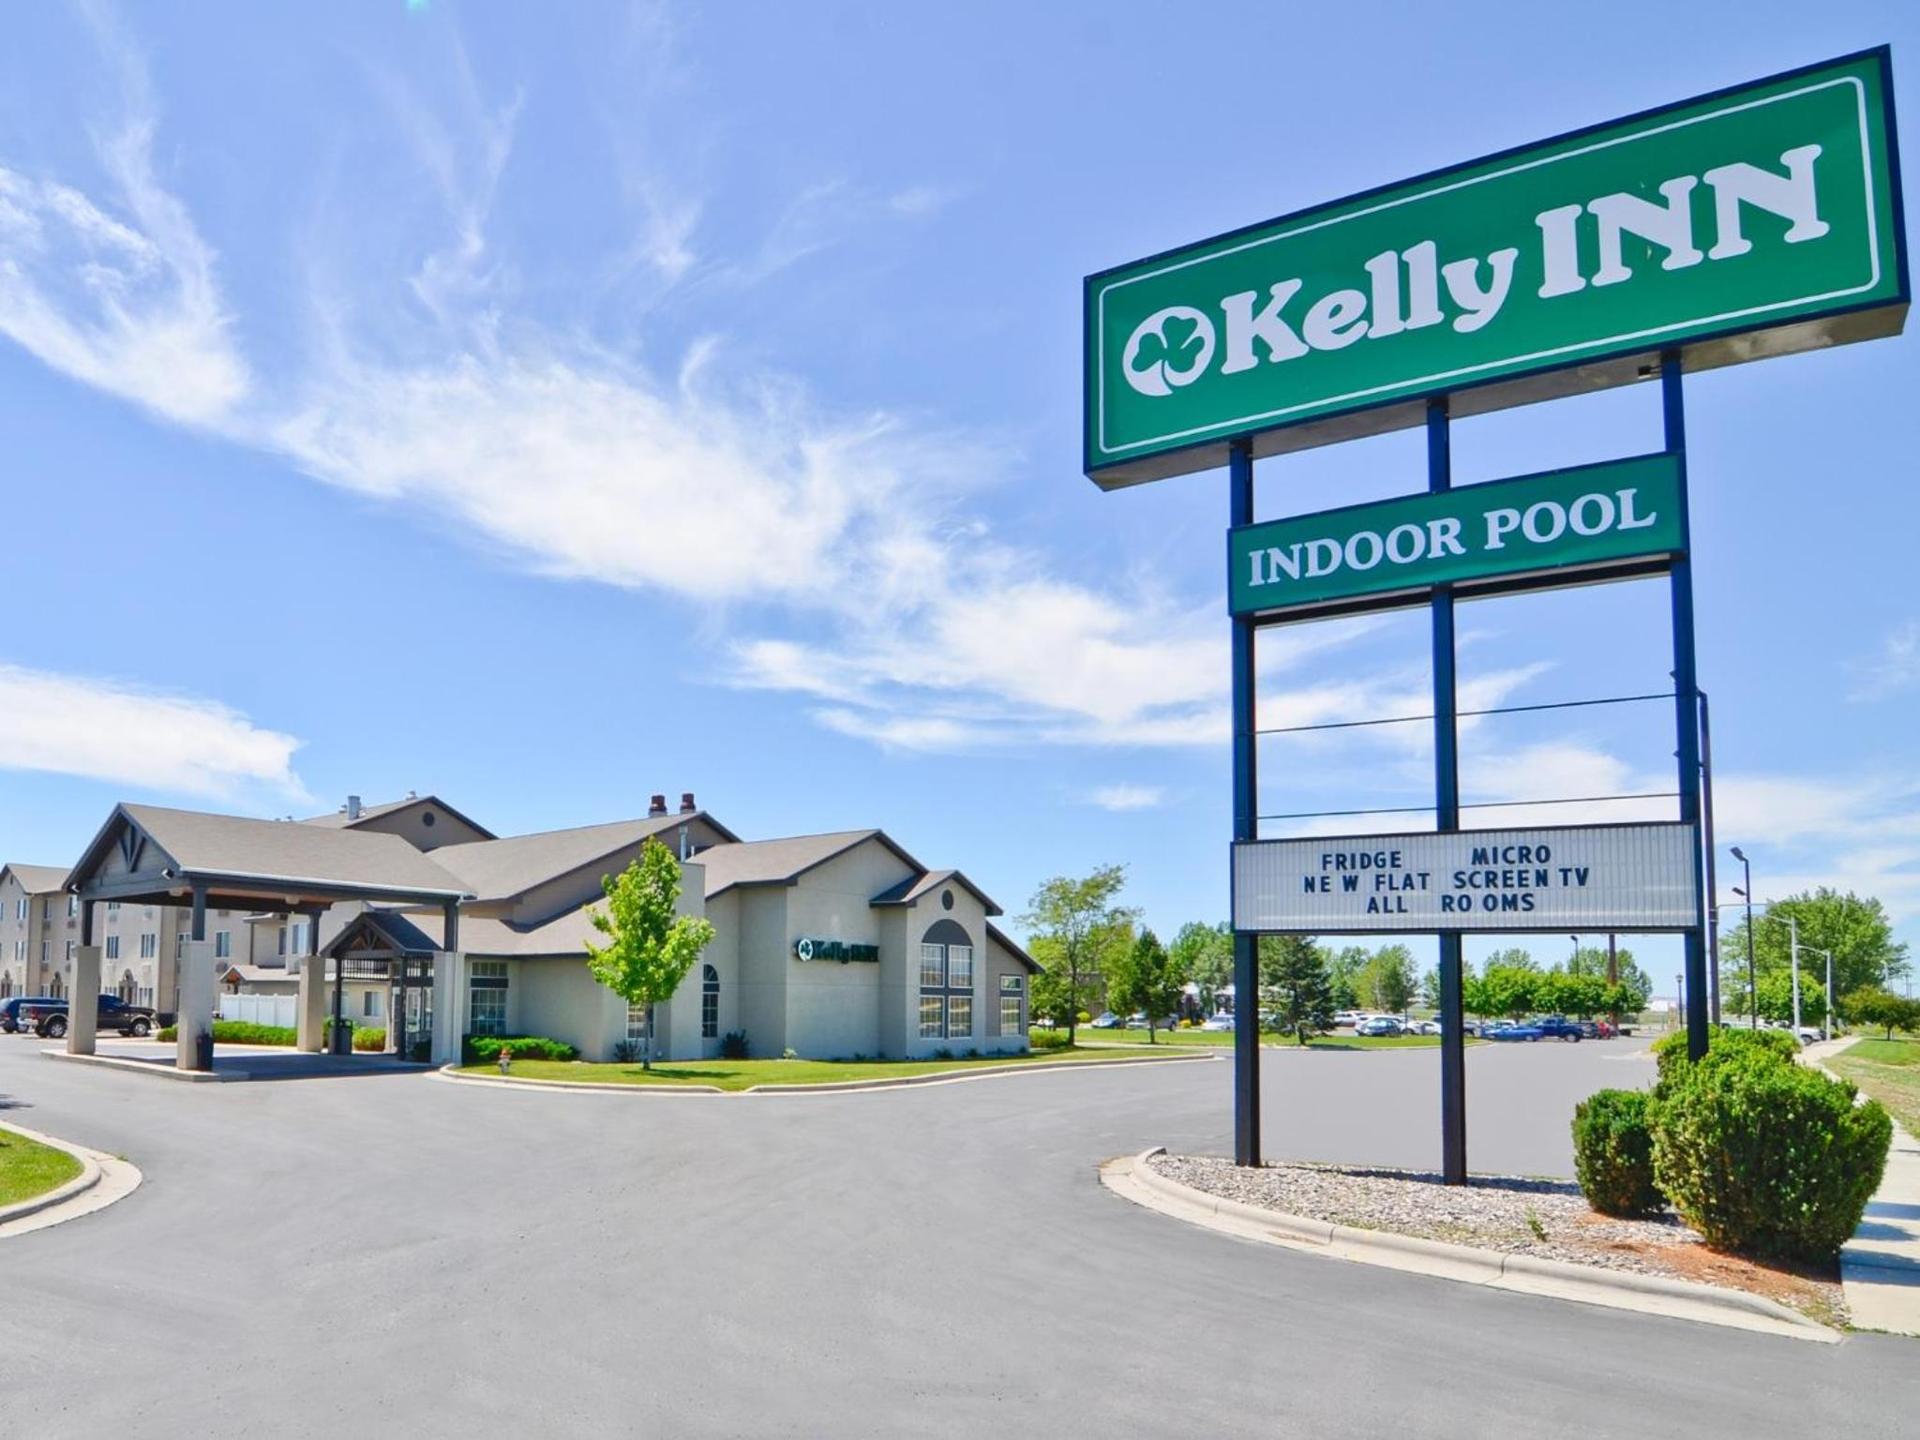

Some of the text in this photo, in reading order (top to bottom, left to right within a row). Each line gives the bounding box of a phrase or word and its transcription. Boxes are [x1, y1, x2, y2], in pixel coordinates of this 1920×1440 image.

[1220, 143, 1830, 374] Kelly INN
[1248, 489, 1657, 586] INDOOR POOL
[1321, 845, 1552, 871] FRIDGE MICRO
[1304, 867, 1590, 893] NEW FLAT SCREEN TV
[1366, 893, 1535, 914] ALL ROOMS
